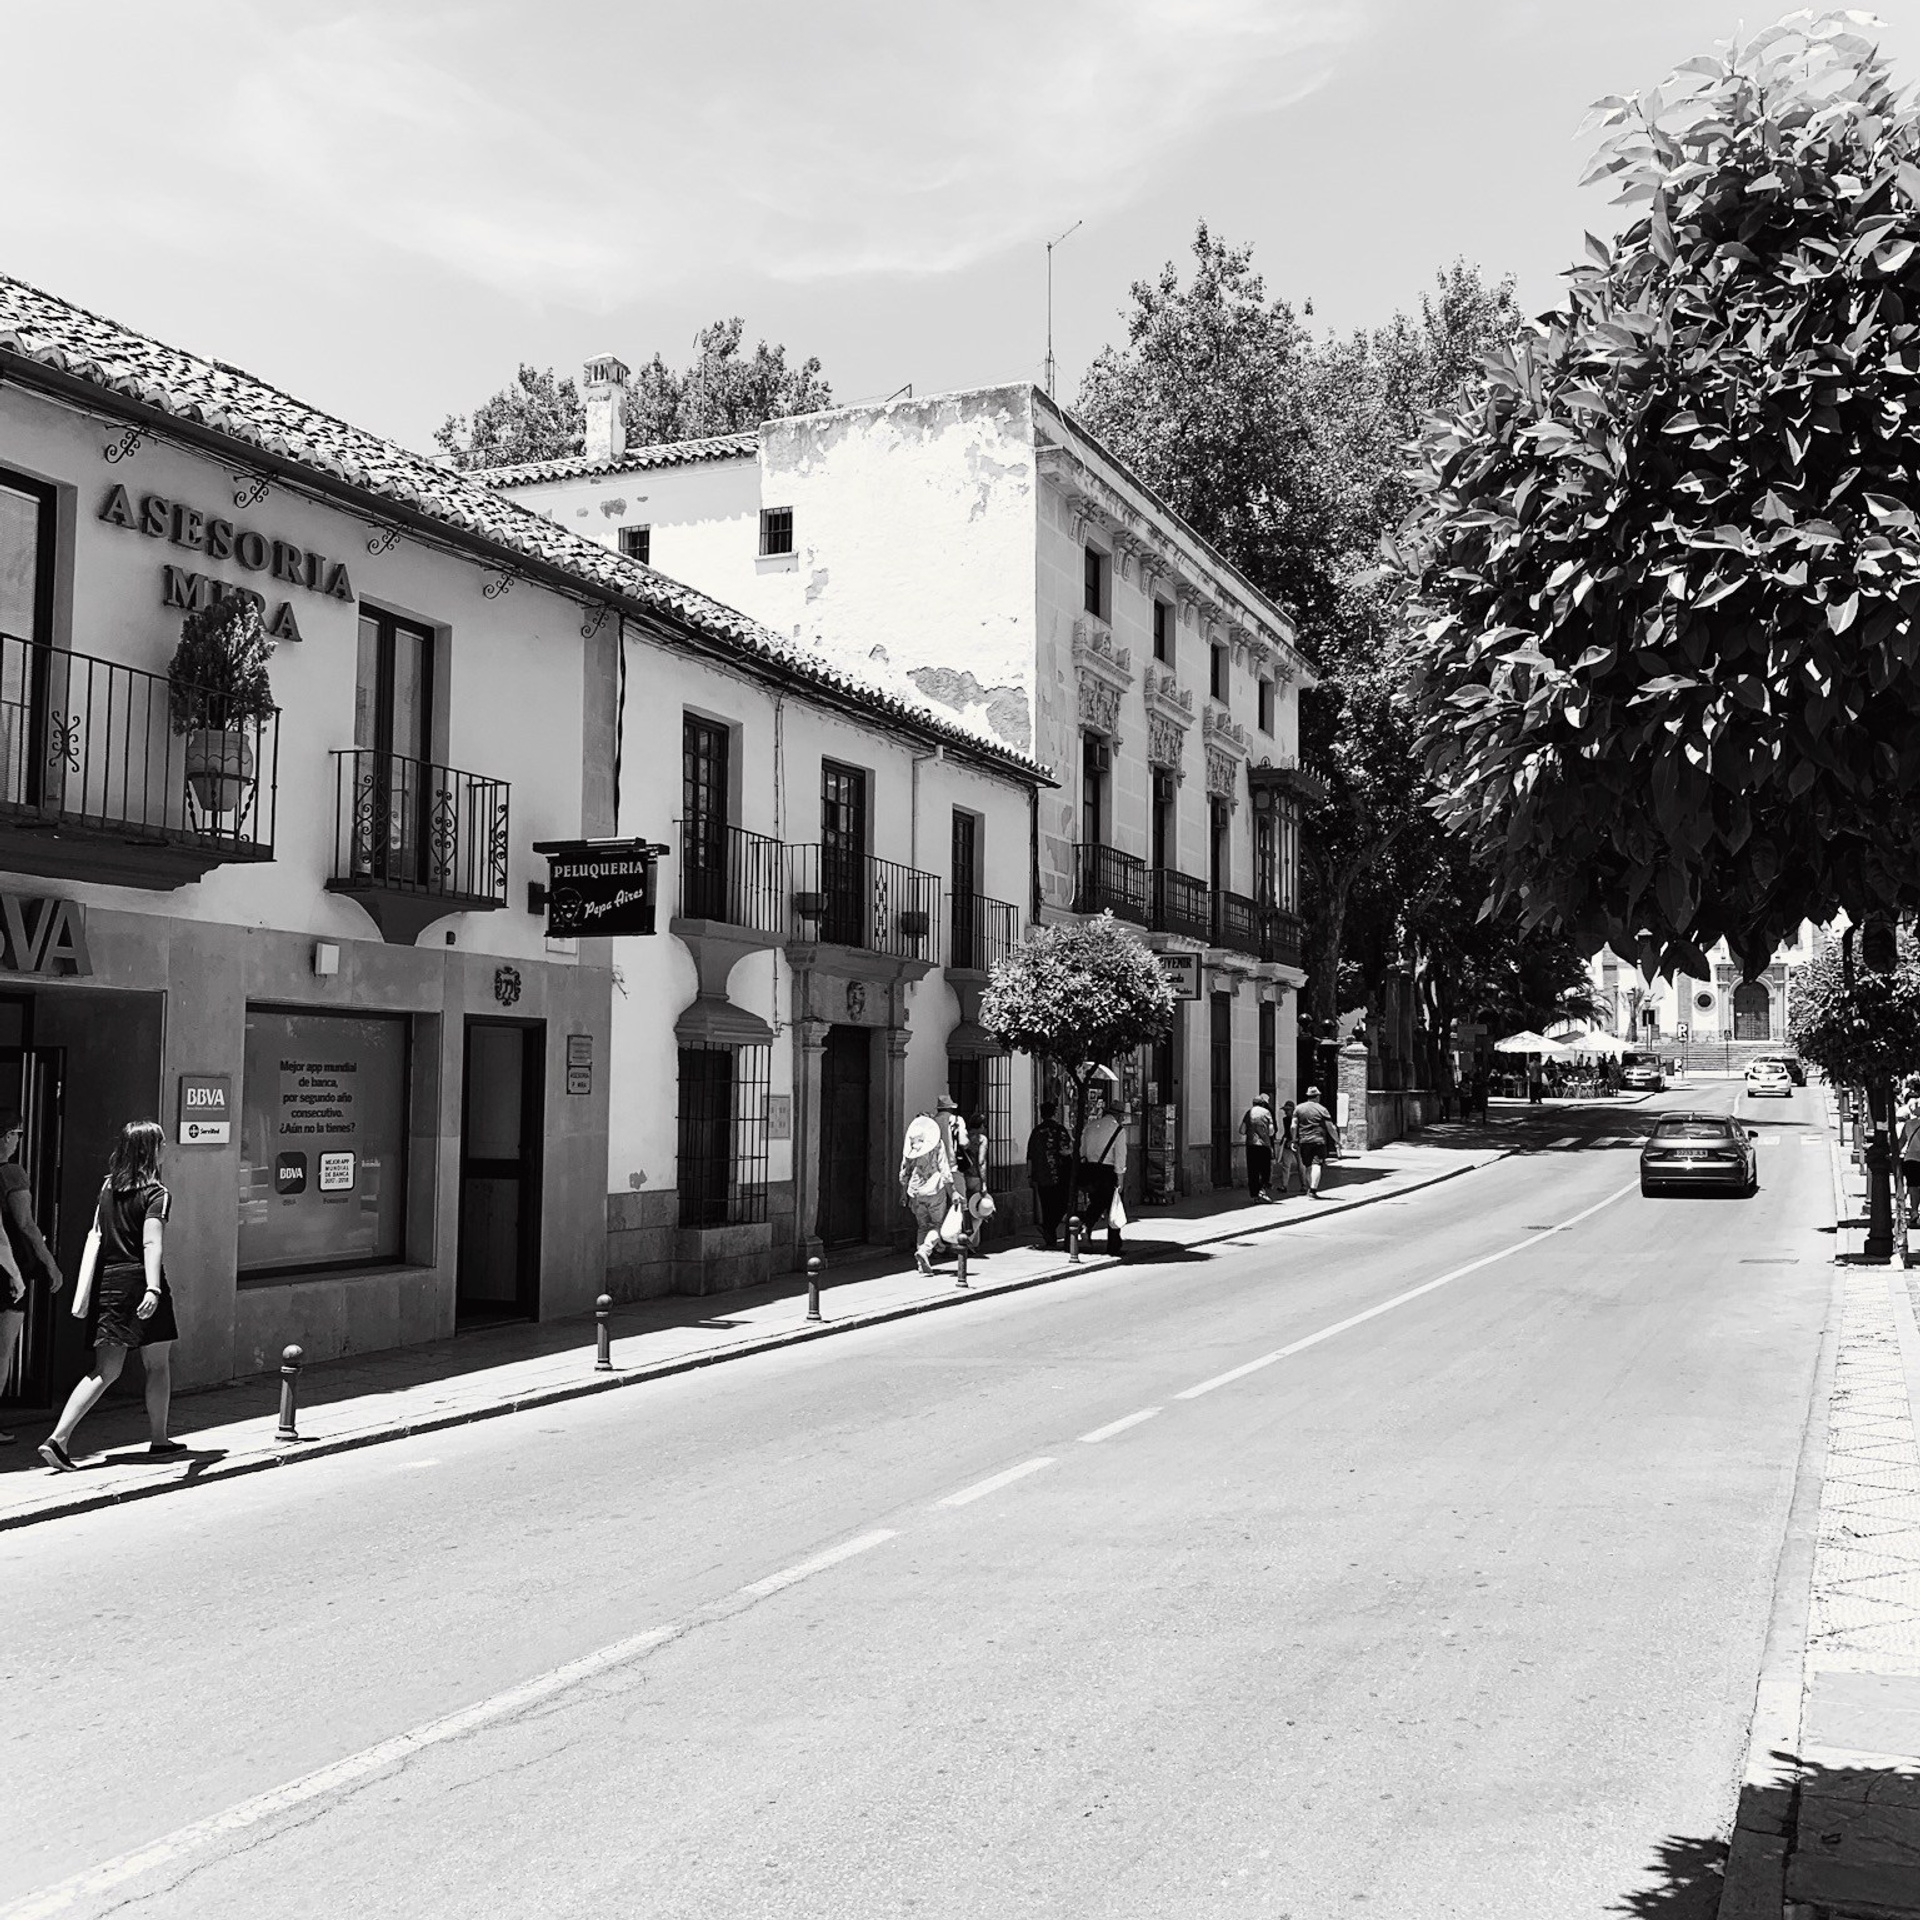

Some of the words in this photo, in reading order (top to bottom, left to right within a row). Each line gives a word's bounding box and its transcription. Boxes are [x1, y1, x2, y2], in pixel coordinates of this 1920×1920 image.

[99, 484, 354, 603] ASESORIA
[553, 861, 644, 879] PELUQUERIA
[614, 888, 643, 907] Aires
[0, 893, 93, 976] VA
[280, 1061, 304, 1073] Mejor
[306, 1064, 322, 1073] app
[324, 1063, 357, 1072] mundial
[299, 1077, 309, 1087] de
[187, 1088, 225, 1105] BBVA
[283, 1094, 298, 1104] por
[300, 1093, 336, 1105] segundo
[337, 1092, 352, 1102] año
[304, 1125, 315, 1133] no
[316, 1122, 324, 1133] la
[326, 1122, 355, 1133] tienes?
[280, 1168, 304, 1179] BBVA
